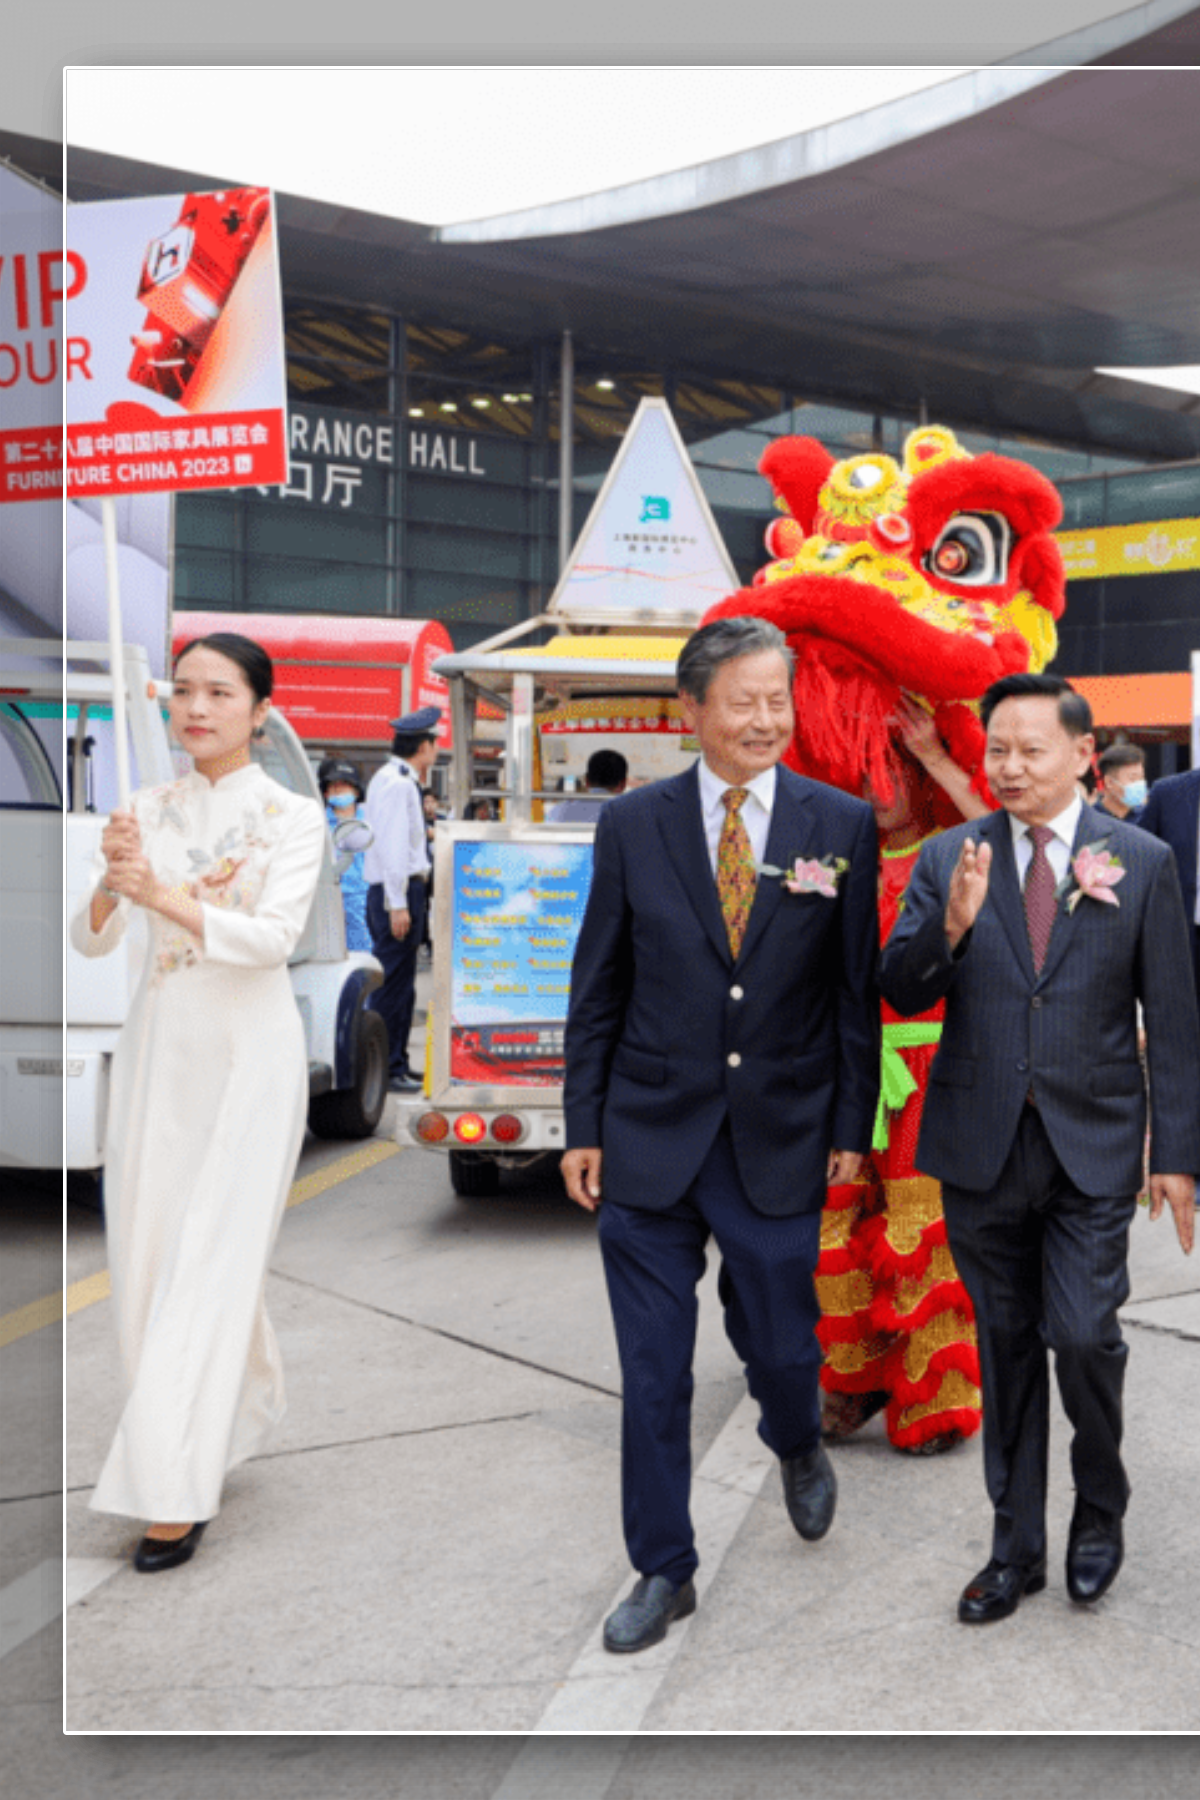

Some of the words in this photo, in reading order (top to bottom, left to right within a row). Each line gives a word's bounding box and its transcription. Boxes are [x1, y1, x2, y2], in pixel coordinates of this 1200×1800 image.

[0, 249, 88, 331] IP
[7, 465, 111, 491] FURNITURE
[117, 460, 178, 482] CHINA
[182, 456, 230, 478] 2023
[409, 430, 485, 475] HALL
[229, 460, 362, 508] 口厅
